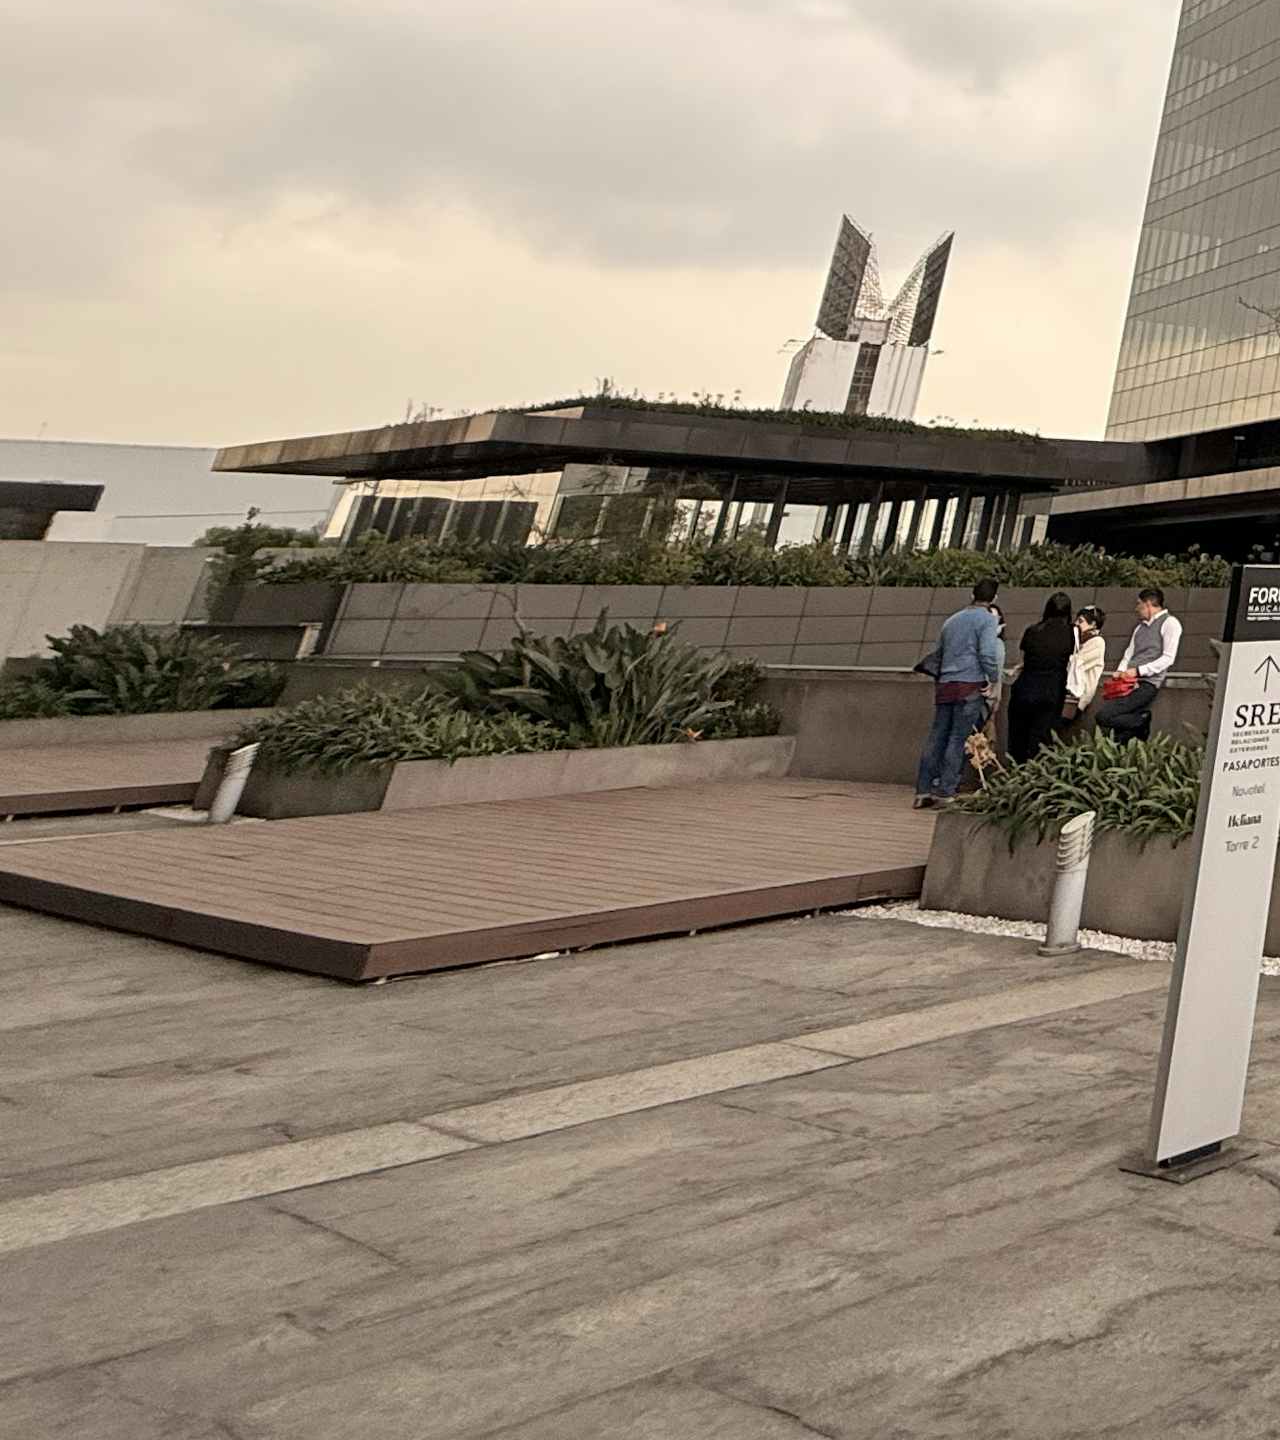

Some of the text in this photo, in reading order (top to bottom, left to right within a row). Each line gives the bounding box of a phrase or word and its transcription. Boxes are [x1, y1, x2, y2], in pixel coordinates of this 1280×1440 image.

[1223, 756, 1280, 772] PASAPORTES
[1225, 835, 1260, 853] Torre 2
